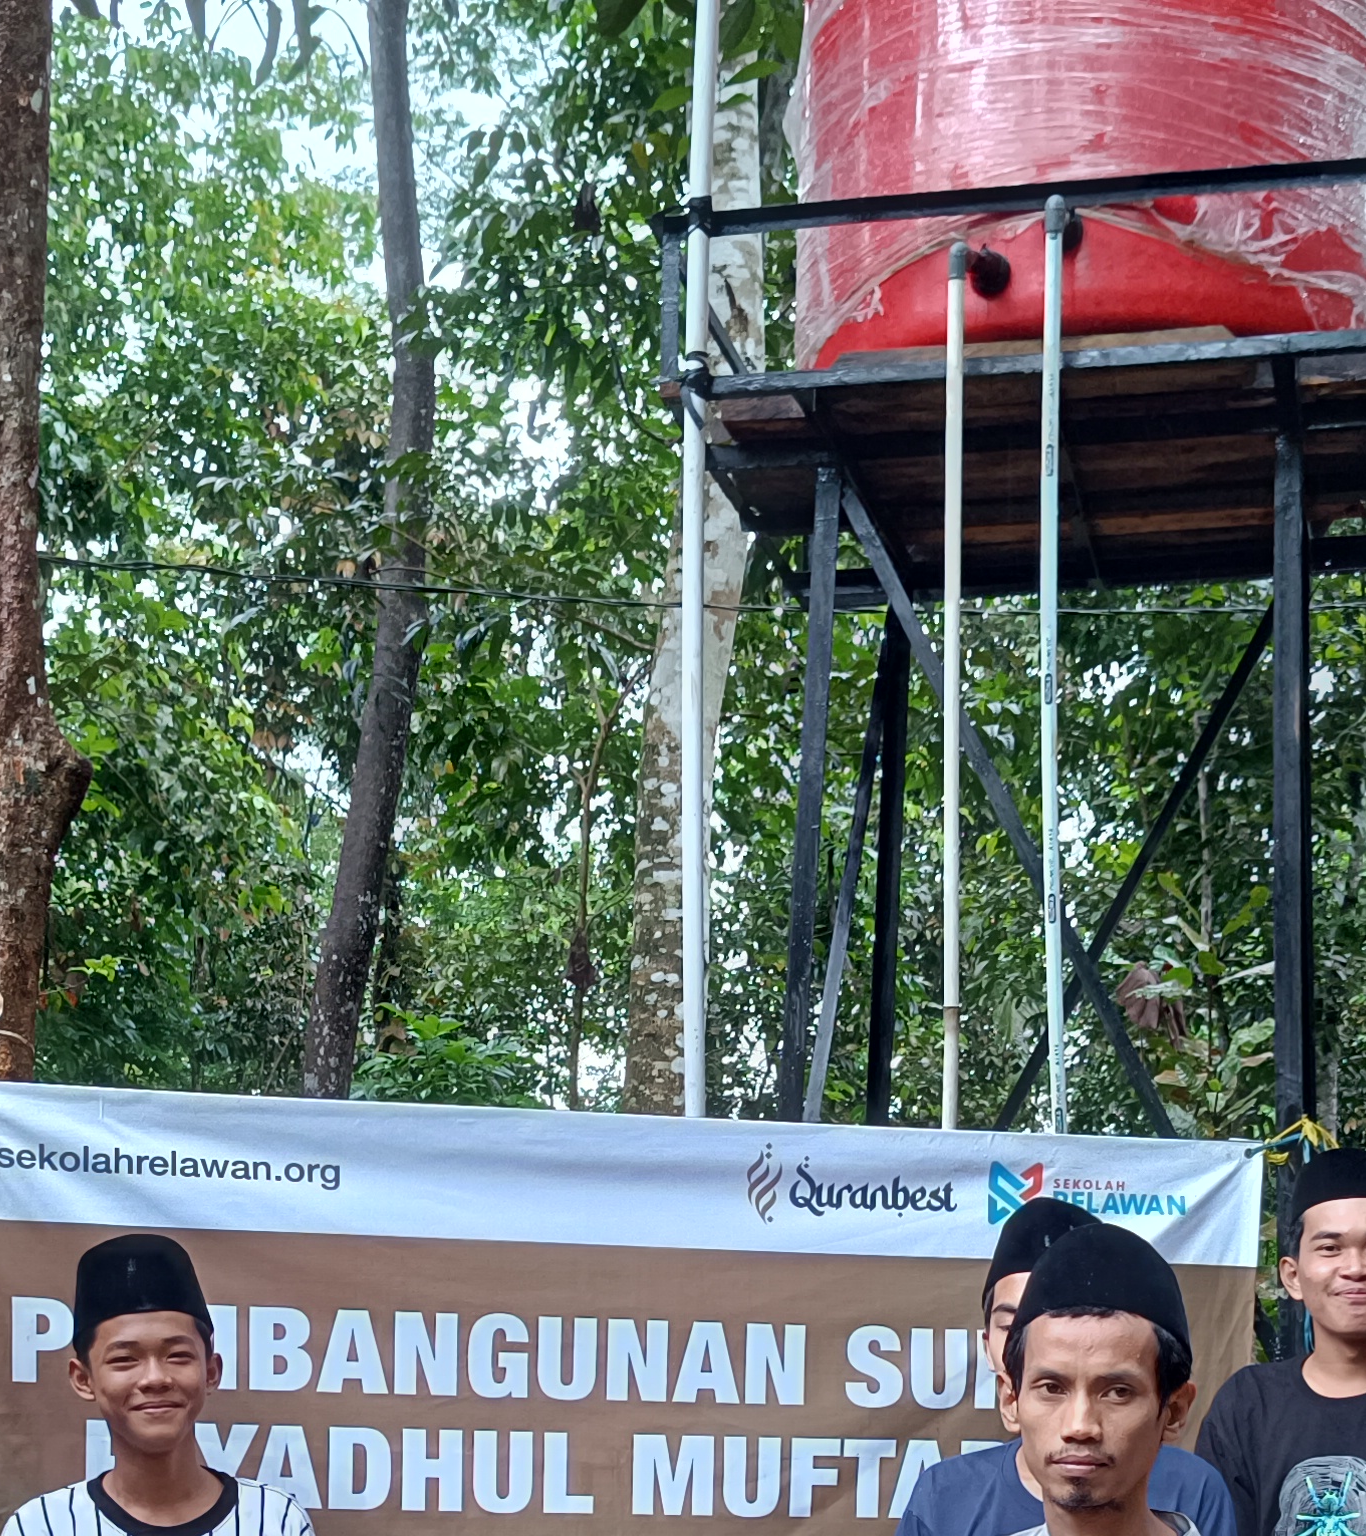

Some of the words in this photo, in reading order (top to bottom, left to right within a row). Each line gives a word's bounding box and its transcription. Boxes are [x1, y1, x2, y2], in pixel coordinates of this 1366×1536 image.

[788, 1155, 958, 1218] Quranbest
[1053, 1178, 1126, 1192] SEKOLAH
[11, 1295, 807, 1407] PBANGUNAN
[85, 1418, 595, 1515] YADHUL
[630, 1434, 1006, 1519] MUFTA
